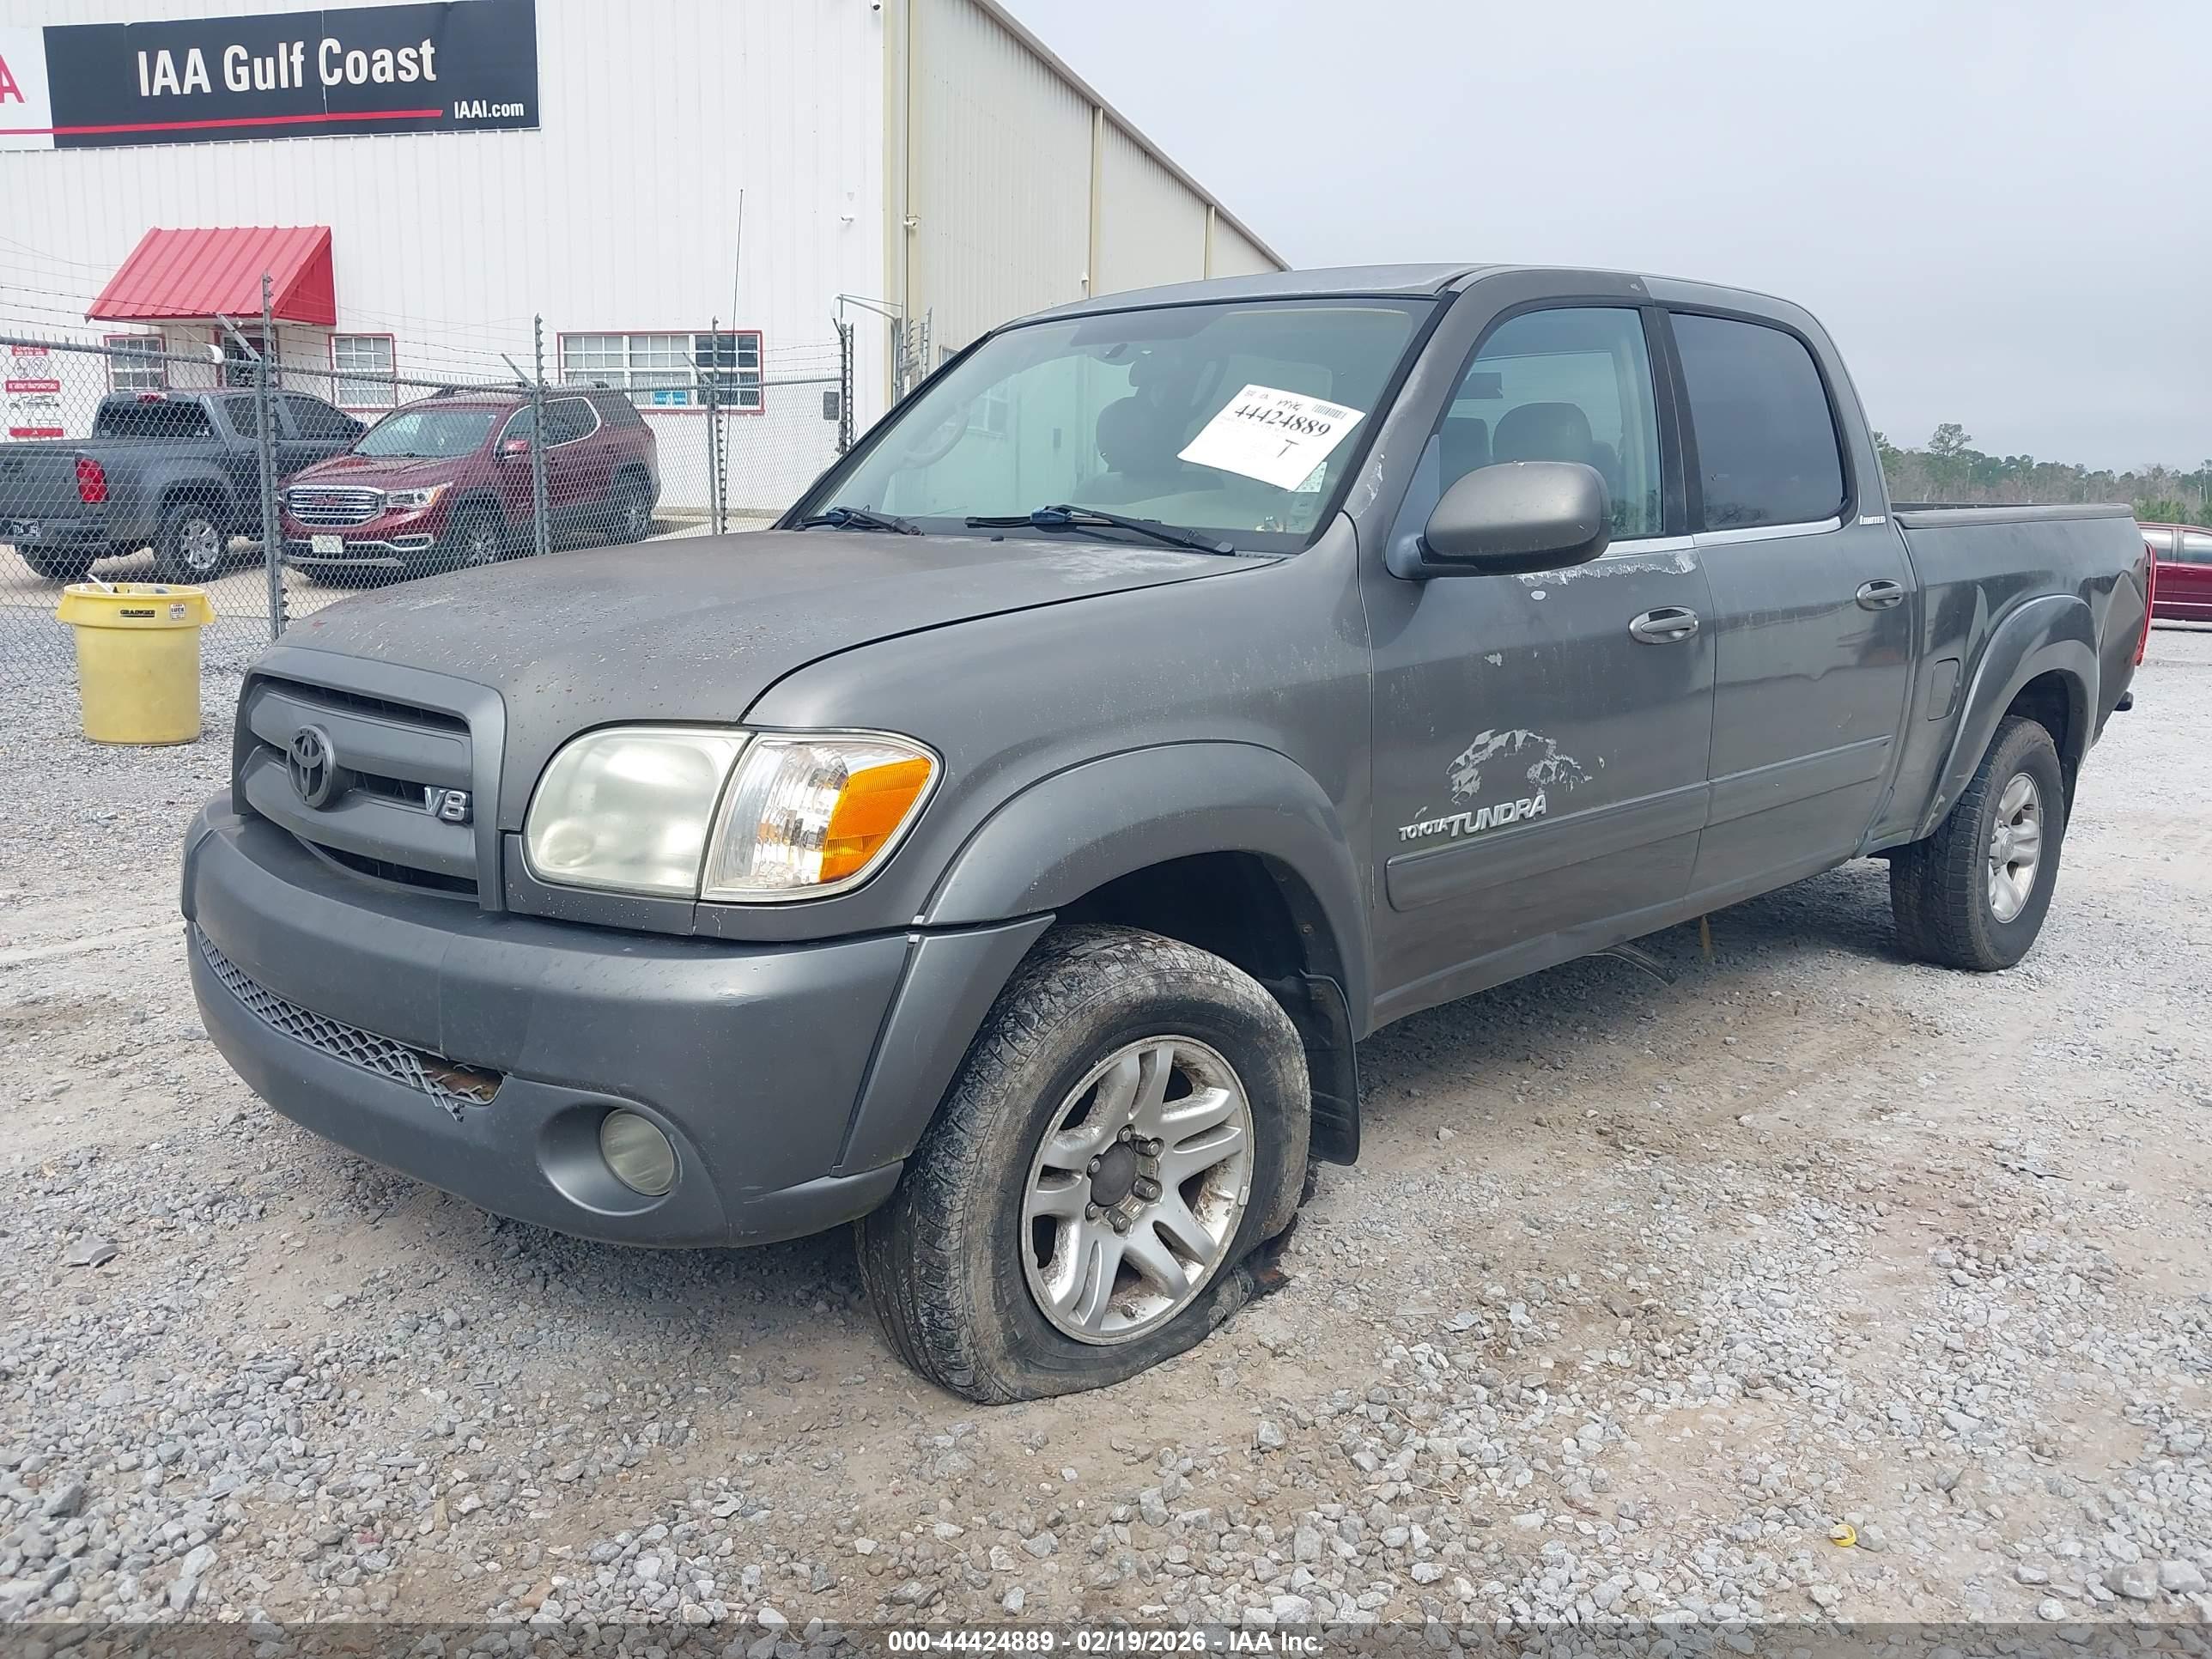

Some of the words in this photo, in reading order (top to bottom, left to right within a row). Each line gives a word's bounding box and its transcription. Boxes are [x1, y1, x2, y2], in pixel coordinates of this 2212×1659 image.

[138, 47, 211, 96] IAA
[223, 40, 306, 93] Gulf
[319, 37, 438, 86] Coast
[453, 100, 525, 120] IAAI.com
[1235, 404, 1331, 437] 44424889
[1277, 439, 1299, 458] T
[424, 786, 470, 822] V8
[1399, 818, 1449, 841] TOYOTA
[1449, 794, 1547, 836] TUNDRA
